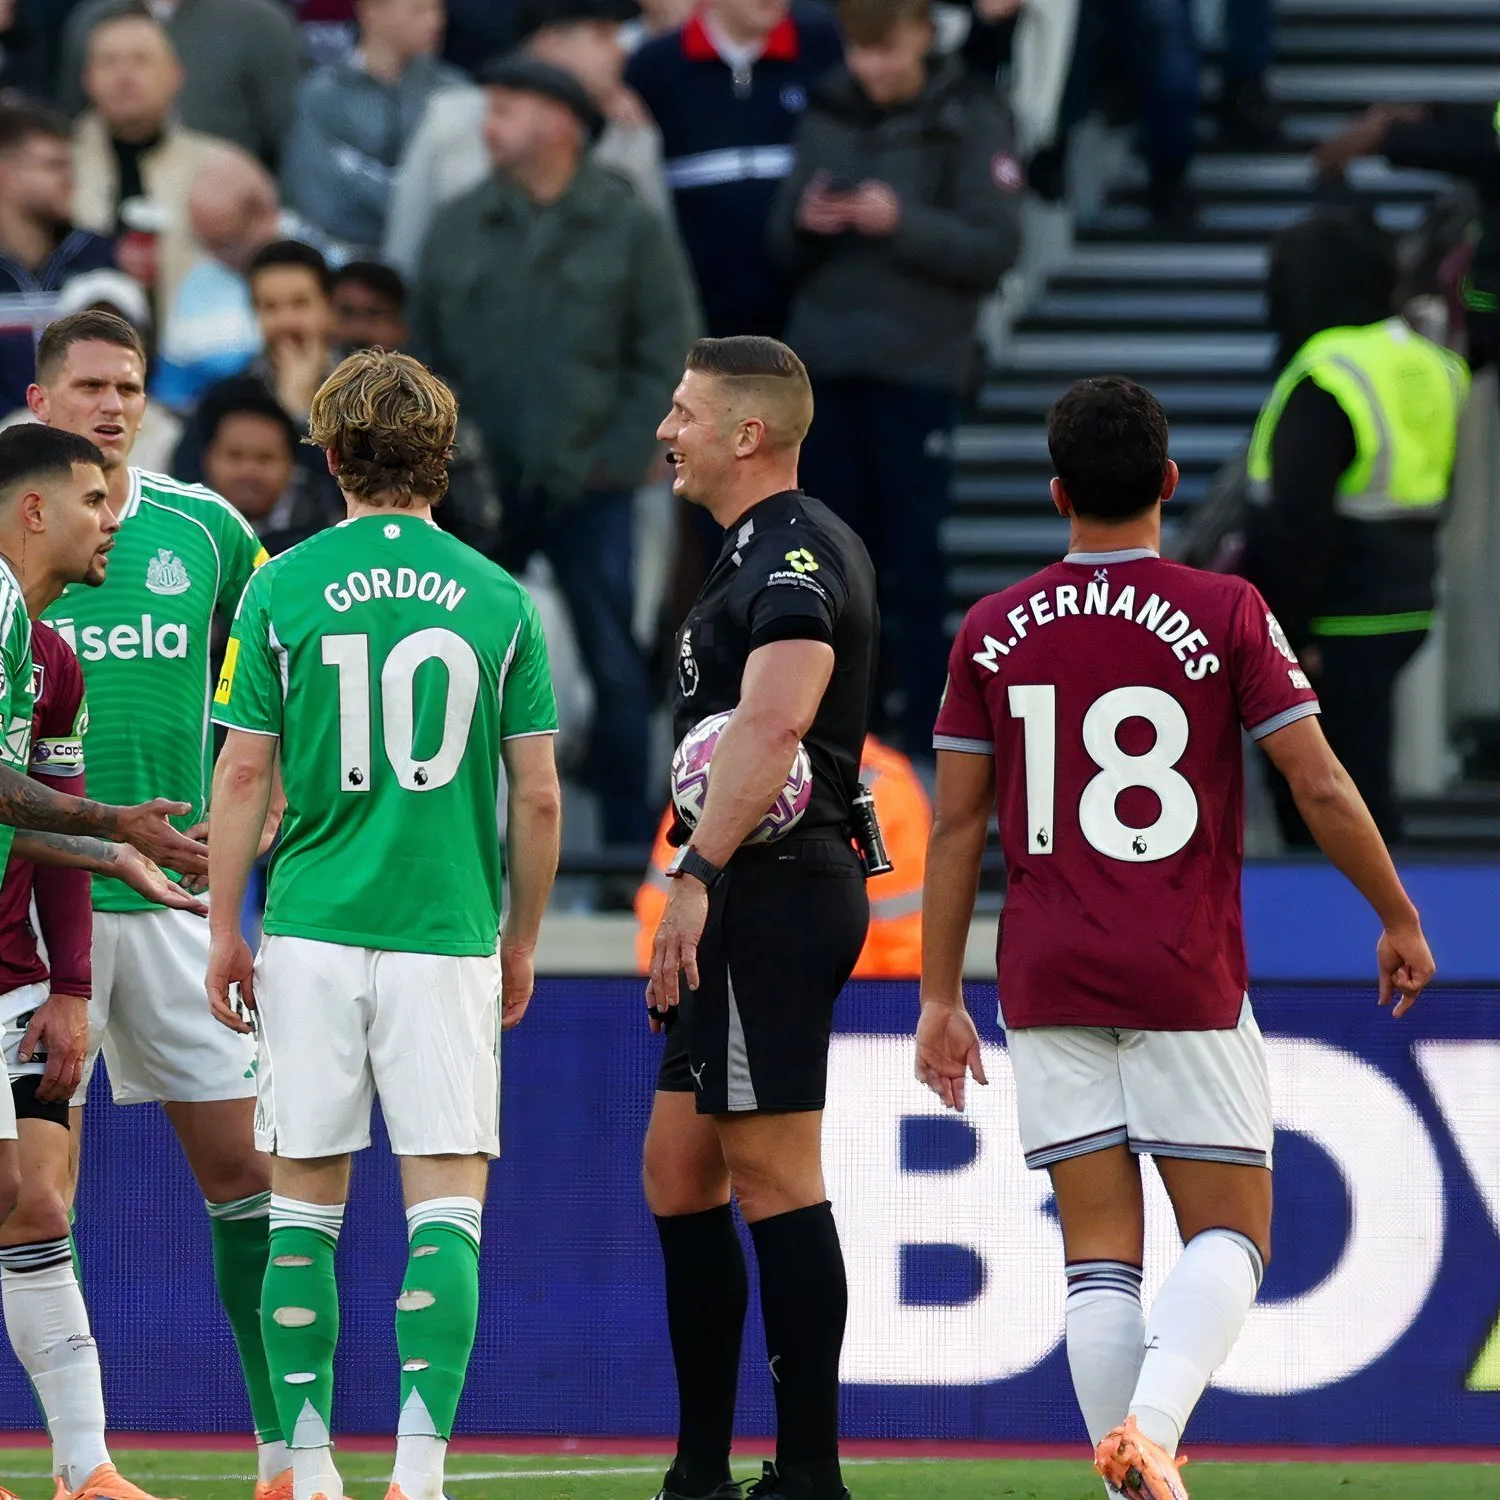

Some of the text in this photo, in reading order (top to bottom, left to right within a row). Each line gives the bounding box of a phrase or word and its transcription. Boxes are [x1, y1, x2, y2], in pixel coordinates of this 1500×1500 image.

[324, 567, 467, 612] GORDON
[972, 581, 1220, 681] M.FERNANDES
[321, 627, 480, 791] 10
[1008, 684, 1198, 862] 18
